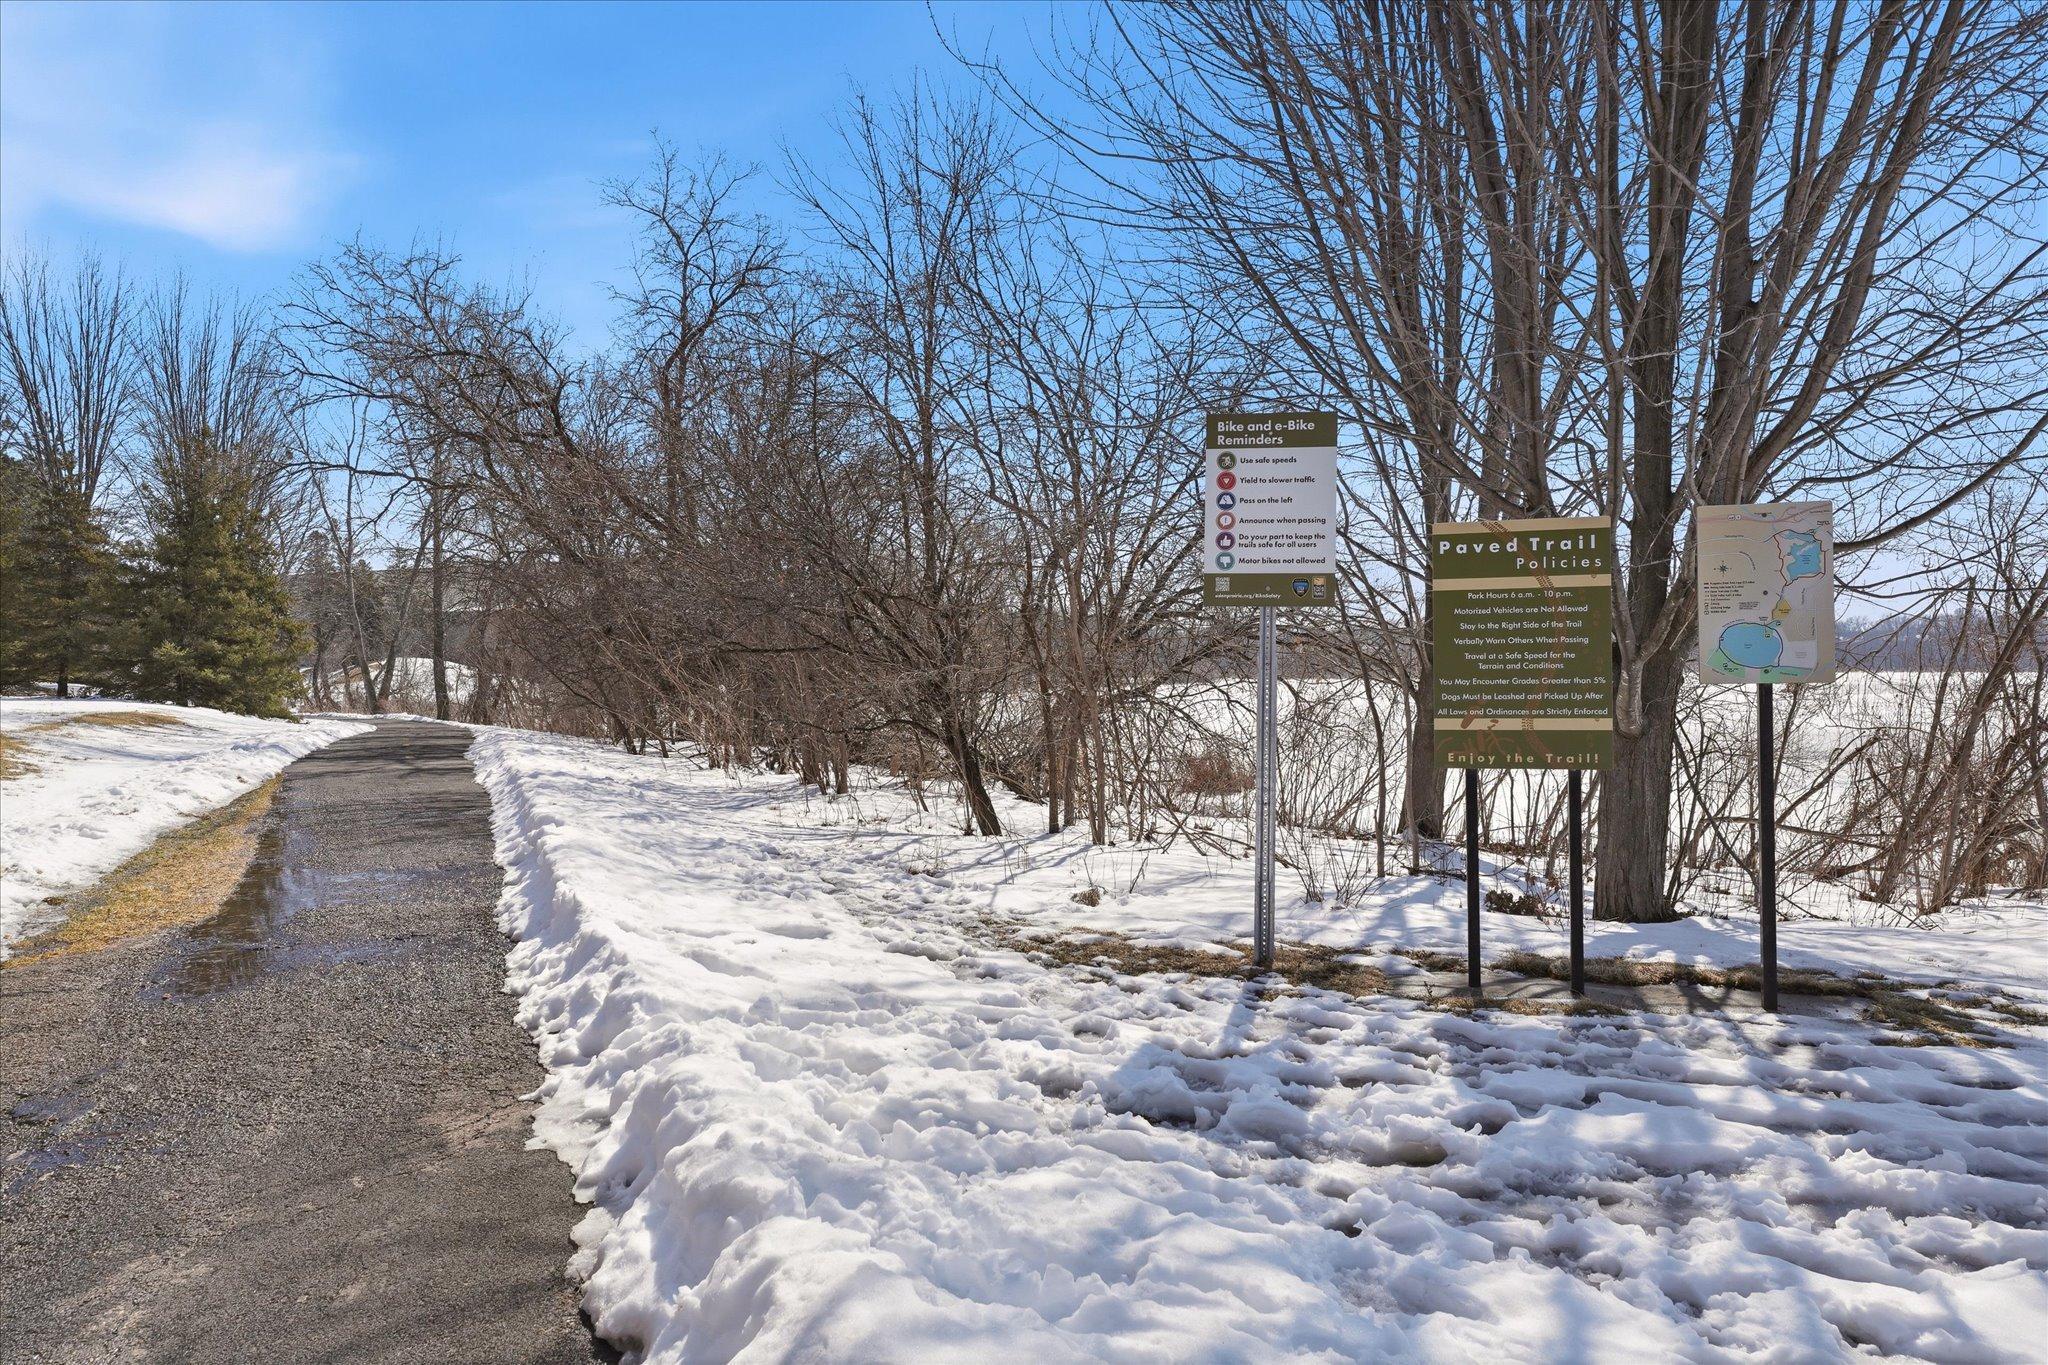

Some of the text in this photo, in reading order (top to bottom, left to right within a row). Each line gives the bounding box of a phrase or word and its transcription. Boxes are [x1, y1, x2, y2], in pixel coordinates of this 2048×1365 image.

[1218, 420, 1315, 432] Bike and e-Bike
[1217, 434, 1283, 445] Reminders
[1440, 535, 1596, 554] Paved Trail
[1516, 556, 1602, 569] Policies
[1556, 591, 1573, 600] p.m.
[1460, 623, 1476, 631] Stay
[1502, 622, 1520, 630] Right
[1454, 638, 1484, 646] Verbally
[1561, 636, 1589, 644] Passing
[1524, 652, 1548, 660] Speed
[1571, 693, 1582, 701] Up
[1547, 708, 1572, 716] Strictly
[1448, 753, 1599, 764] Enjoy the Trail!
